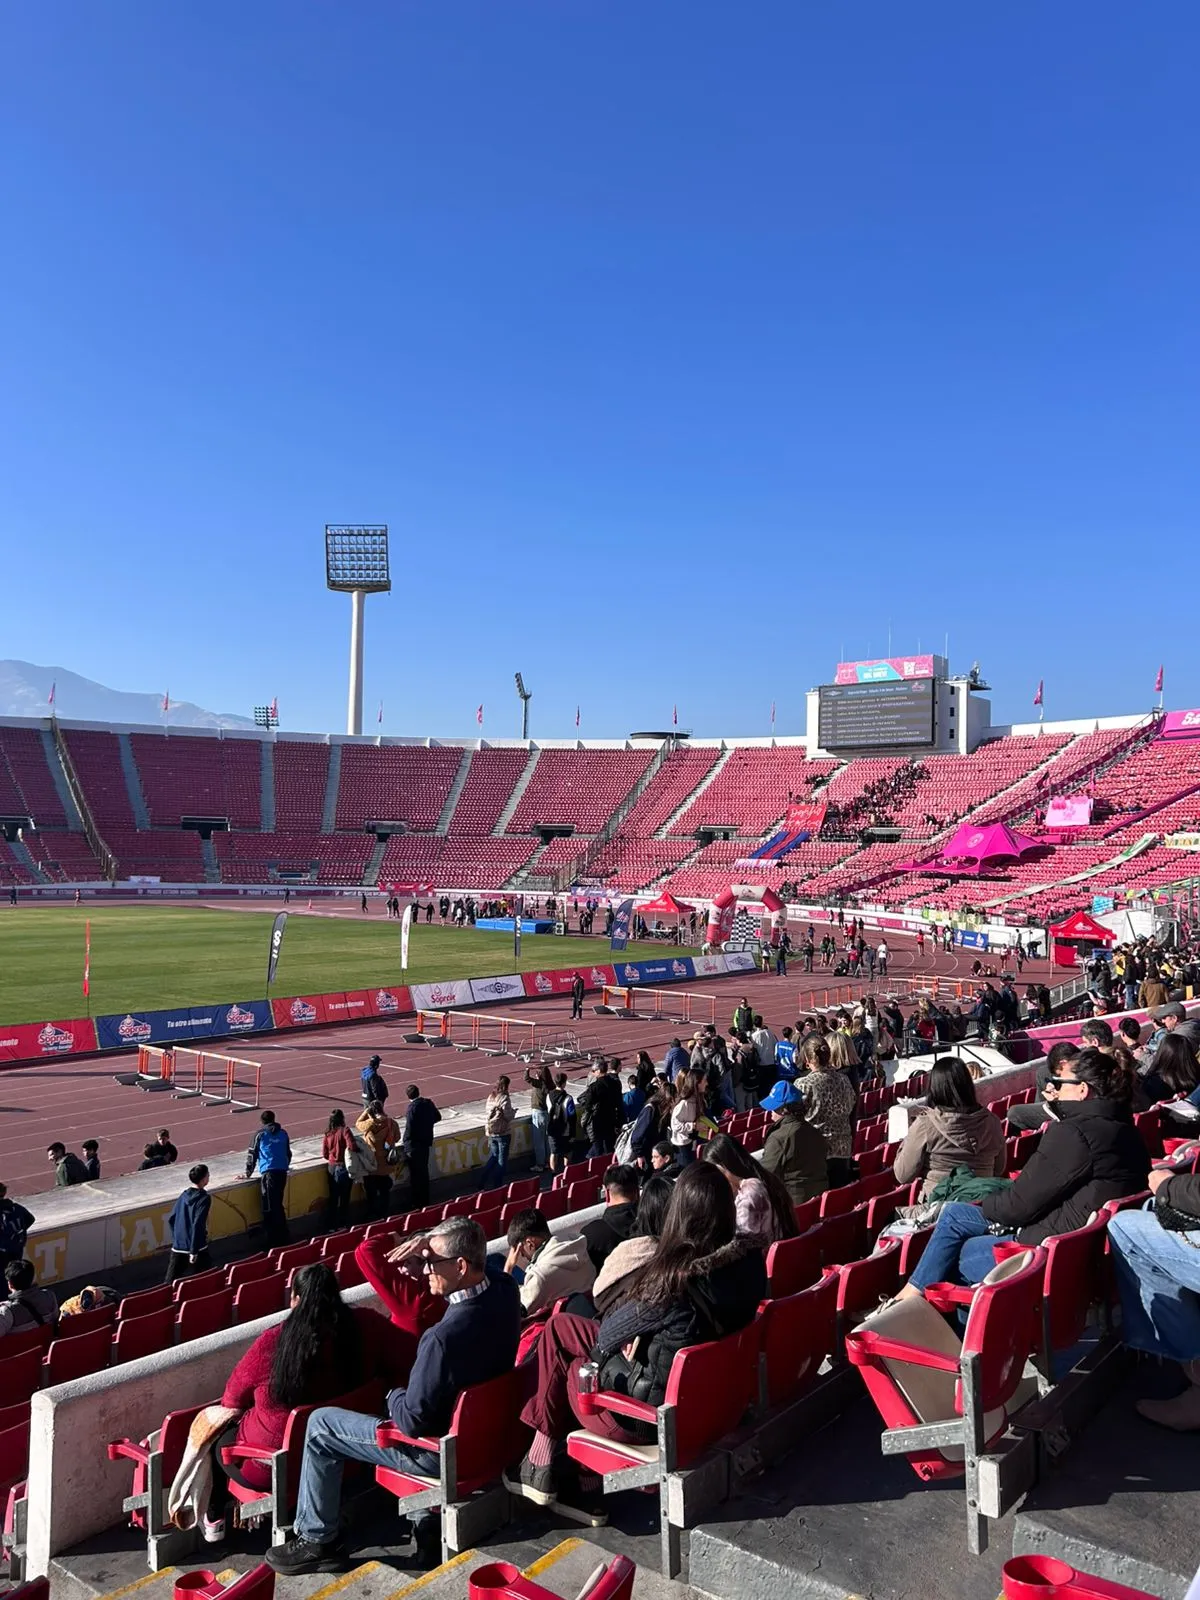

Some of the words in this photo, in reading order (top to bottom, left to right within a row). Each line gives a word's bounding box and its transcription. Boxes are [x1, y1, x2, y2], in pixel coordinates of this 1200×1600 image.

[430, 993, 457, 1005] Soprole
[290, 1004, 317, 1016] Soprole
[167, 1020, 174, 1028] Tu
[175, 1019, 188, 1027] otro
[226, 1012, 255, 1024] Soprole
[118, 1022, 151, 1037] Soprole
[38, 1031, 74, 1046] Soprole
